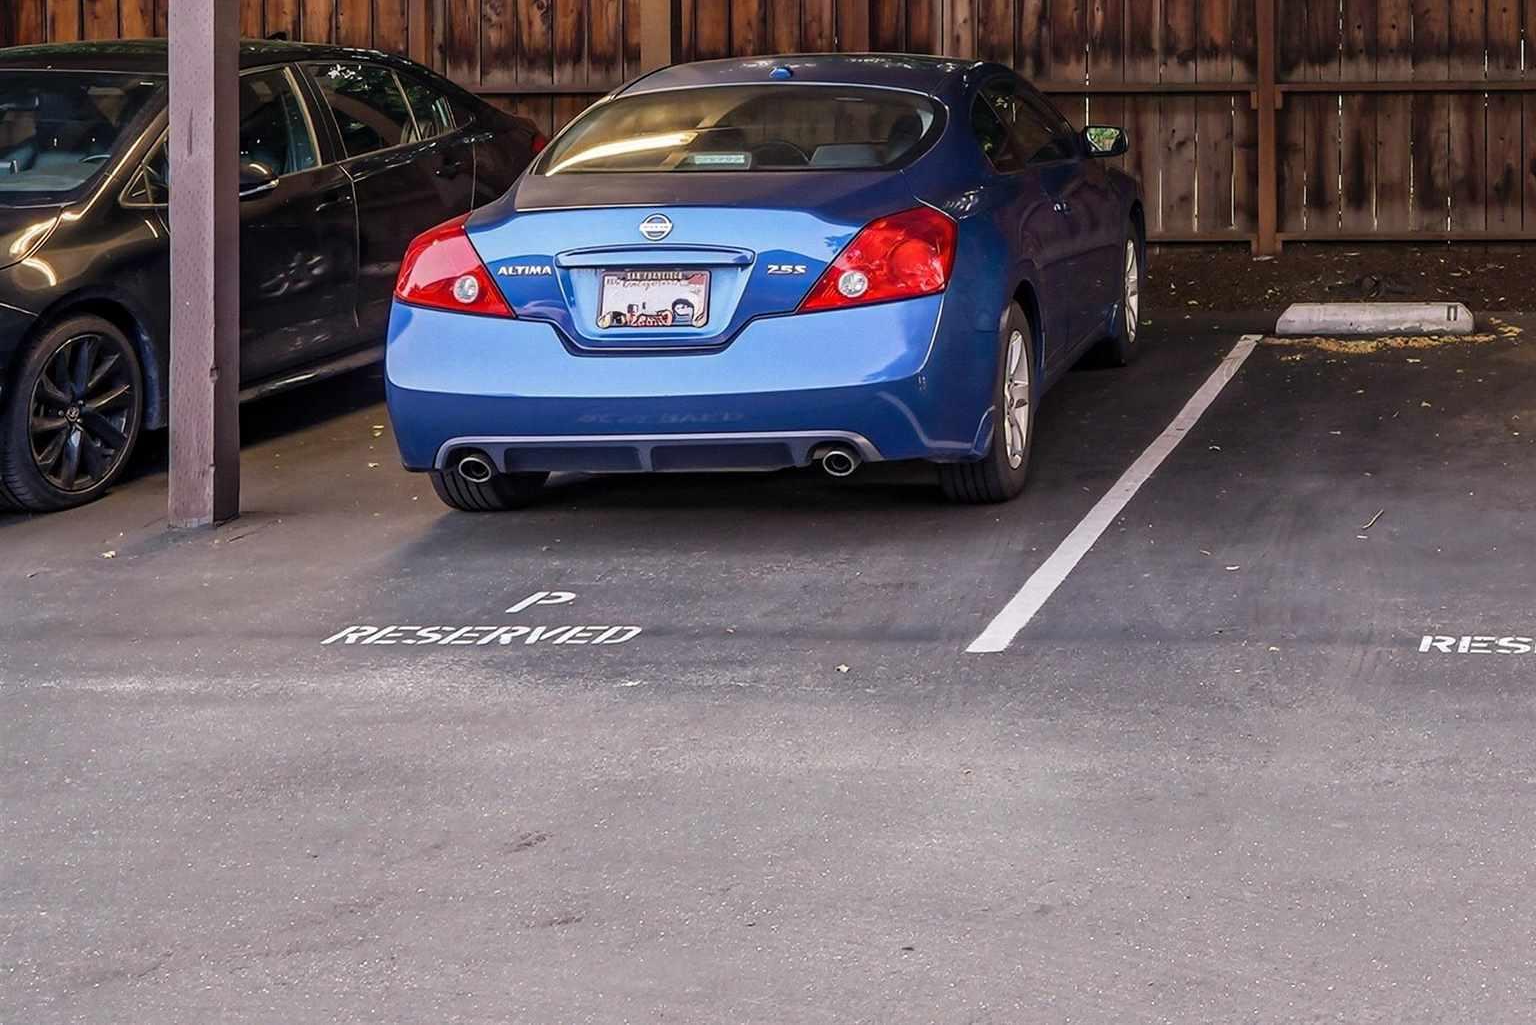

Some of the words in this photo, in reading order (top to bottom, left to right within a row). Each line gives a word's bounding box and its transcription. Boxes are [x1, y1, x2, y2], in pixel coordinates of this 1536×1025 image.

[496, 264, 552, 276] ALTIMA
[505, 591, 577, 614] P
[320, 625, 643, 646] RESERVED
